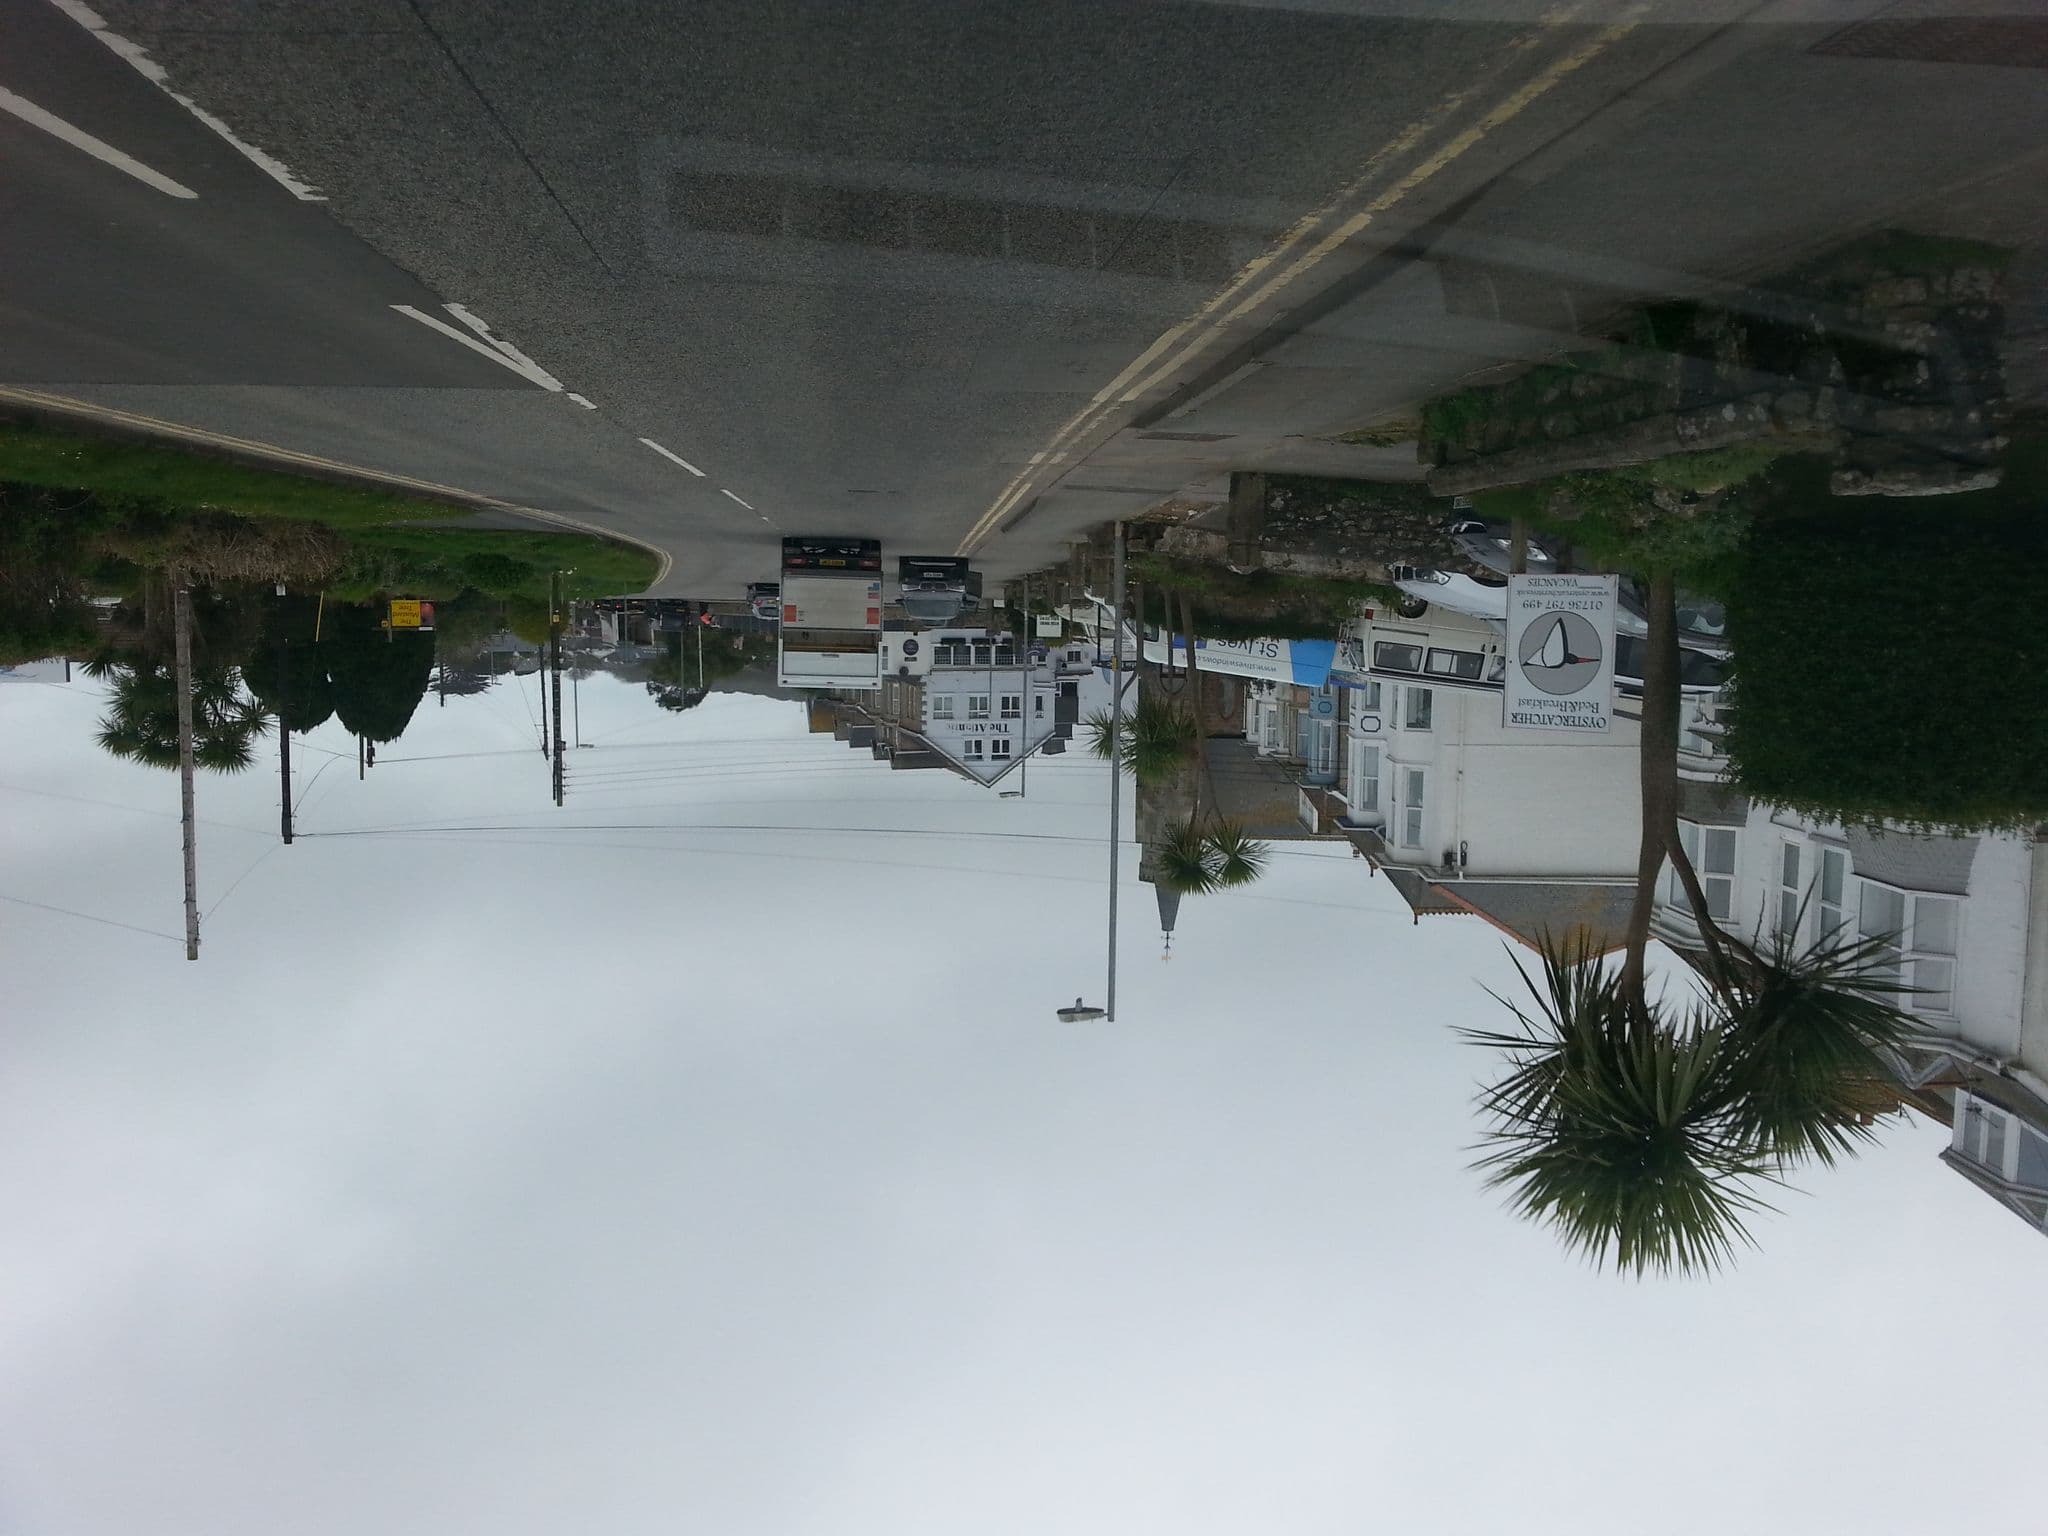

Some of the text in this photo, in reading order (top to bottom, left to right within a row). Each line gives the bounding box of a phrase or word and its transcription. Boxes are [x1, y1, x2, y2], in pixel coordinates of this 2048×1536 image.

[1528, 578, 1578, 587] VACANCIES
[1522, 599, 1603, 610] 01736 797 499
[1511, 712, 1606, 728] OYSTERCATCHER
